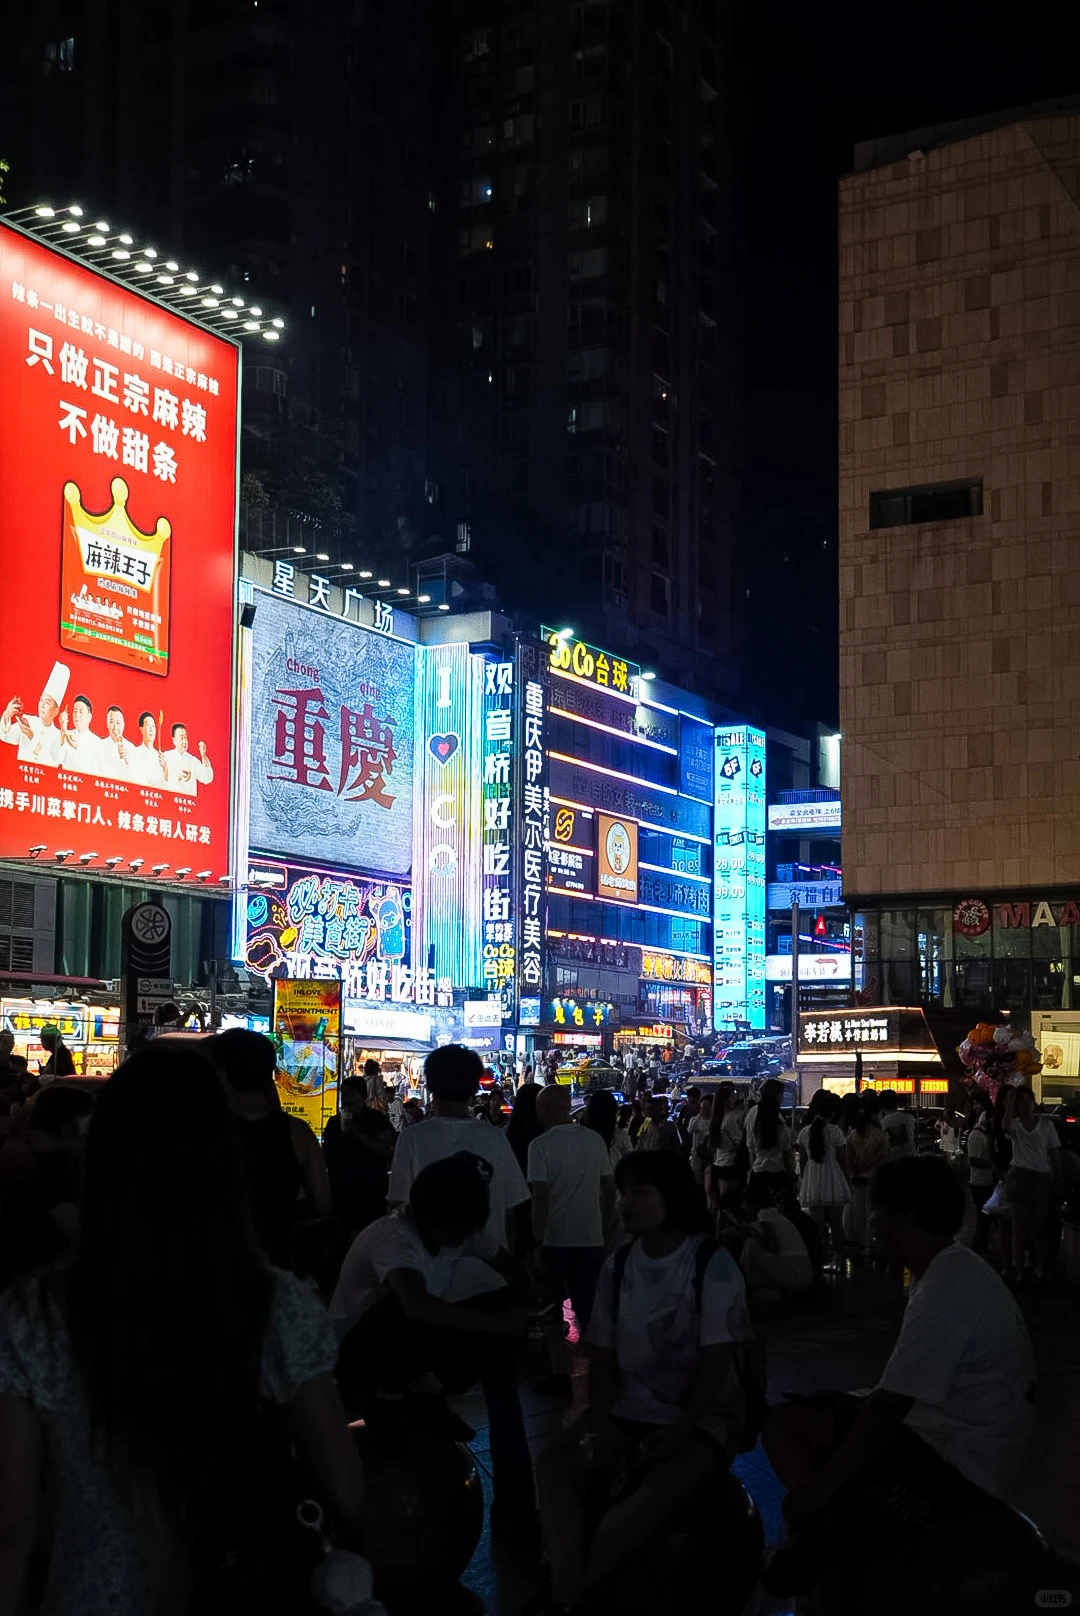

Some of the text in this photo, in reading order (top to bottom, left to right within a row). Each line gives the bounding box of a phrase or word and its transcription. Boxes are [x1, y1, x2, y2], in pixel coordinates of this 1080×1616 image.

[11, 281, 144, 361] 辣条一出生就不是甜的
[25, 327, 207, 443] 只做正宗麻辣
[58, 400, 178, 484] 不做甜条
[85, 541, 151, 585] 麻辣王子
[272, 559, 394, 635] 星天广场
[266, 687, 397, 810] 重慶
[484, 662, 513, 921] 观音桥好吃街
[300, 916, 368, 958] 美食街
[483, 943, 515, 958] CoCo
[483, 958, 514, 978] 台球
